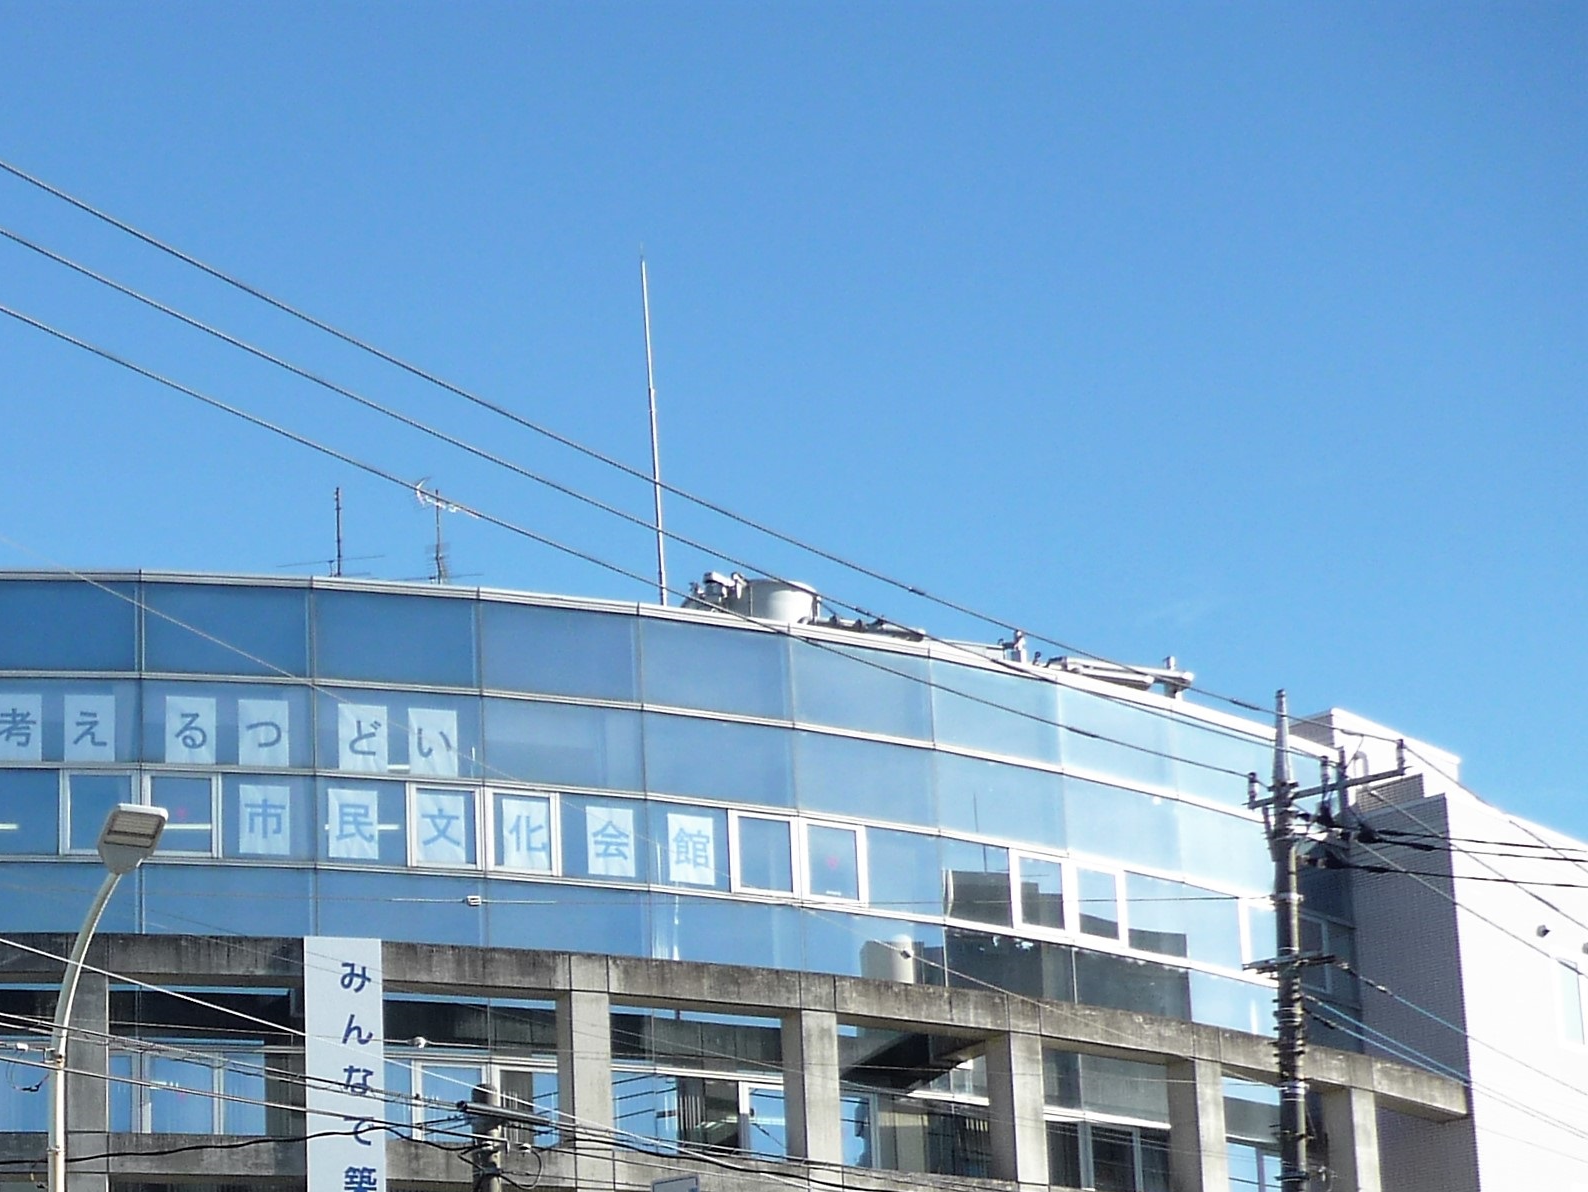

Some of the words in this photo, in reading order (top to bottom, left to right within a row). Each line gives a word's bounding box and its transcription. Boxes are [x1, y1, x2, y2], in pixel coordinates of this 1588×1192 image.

[244, 799, 712, 868] 市民文化会館
